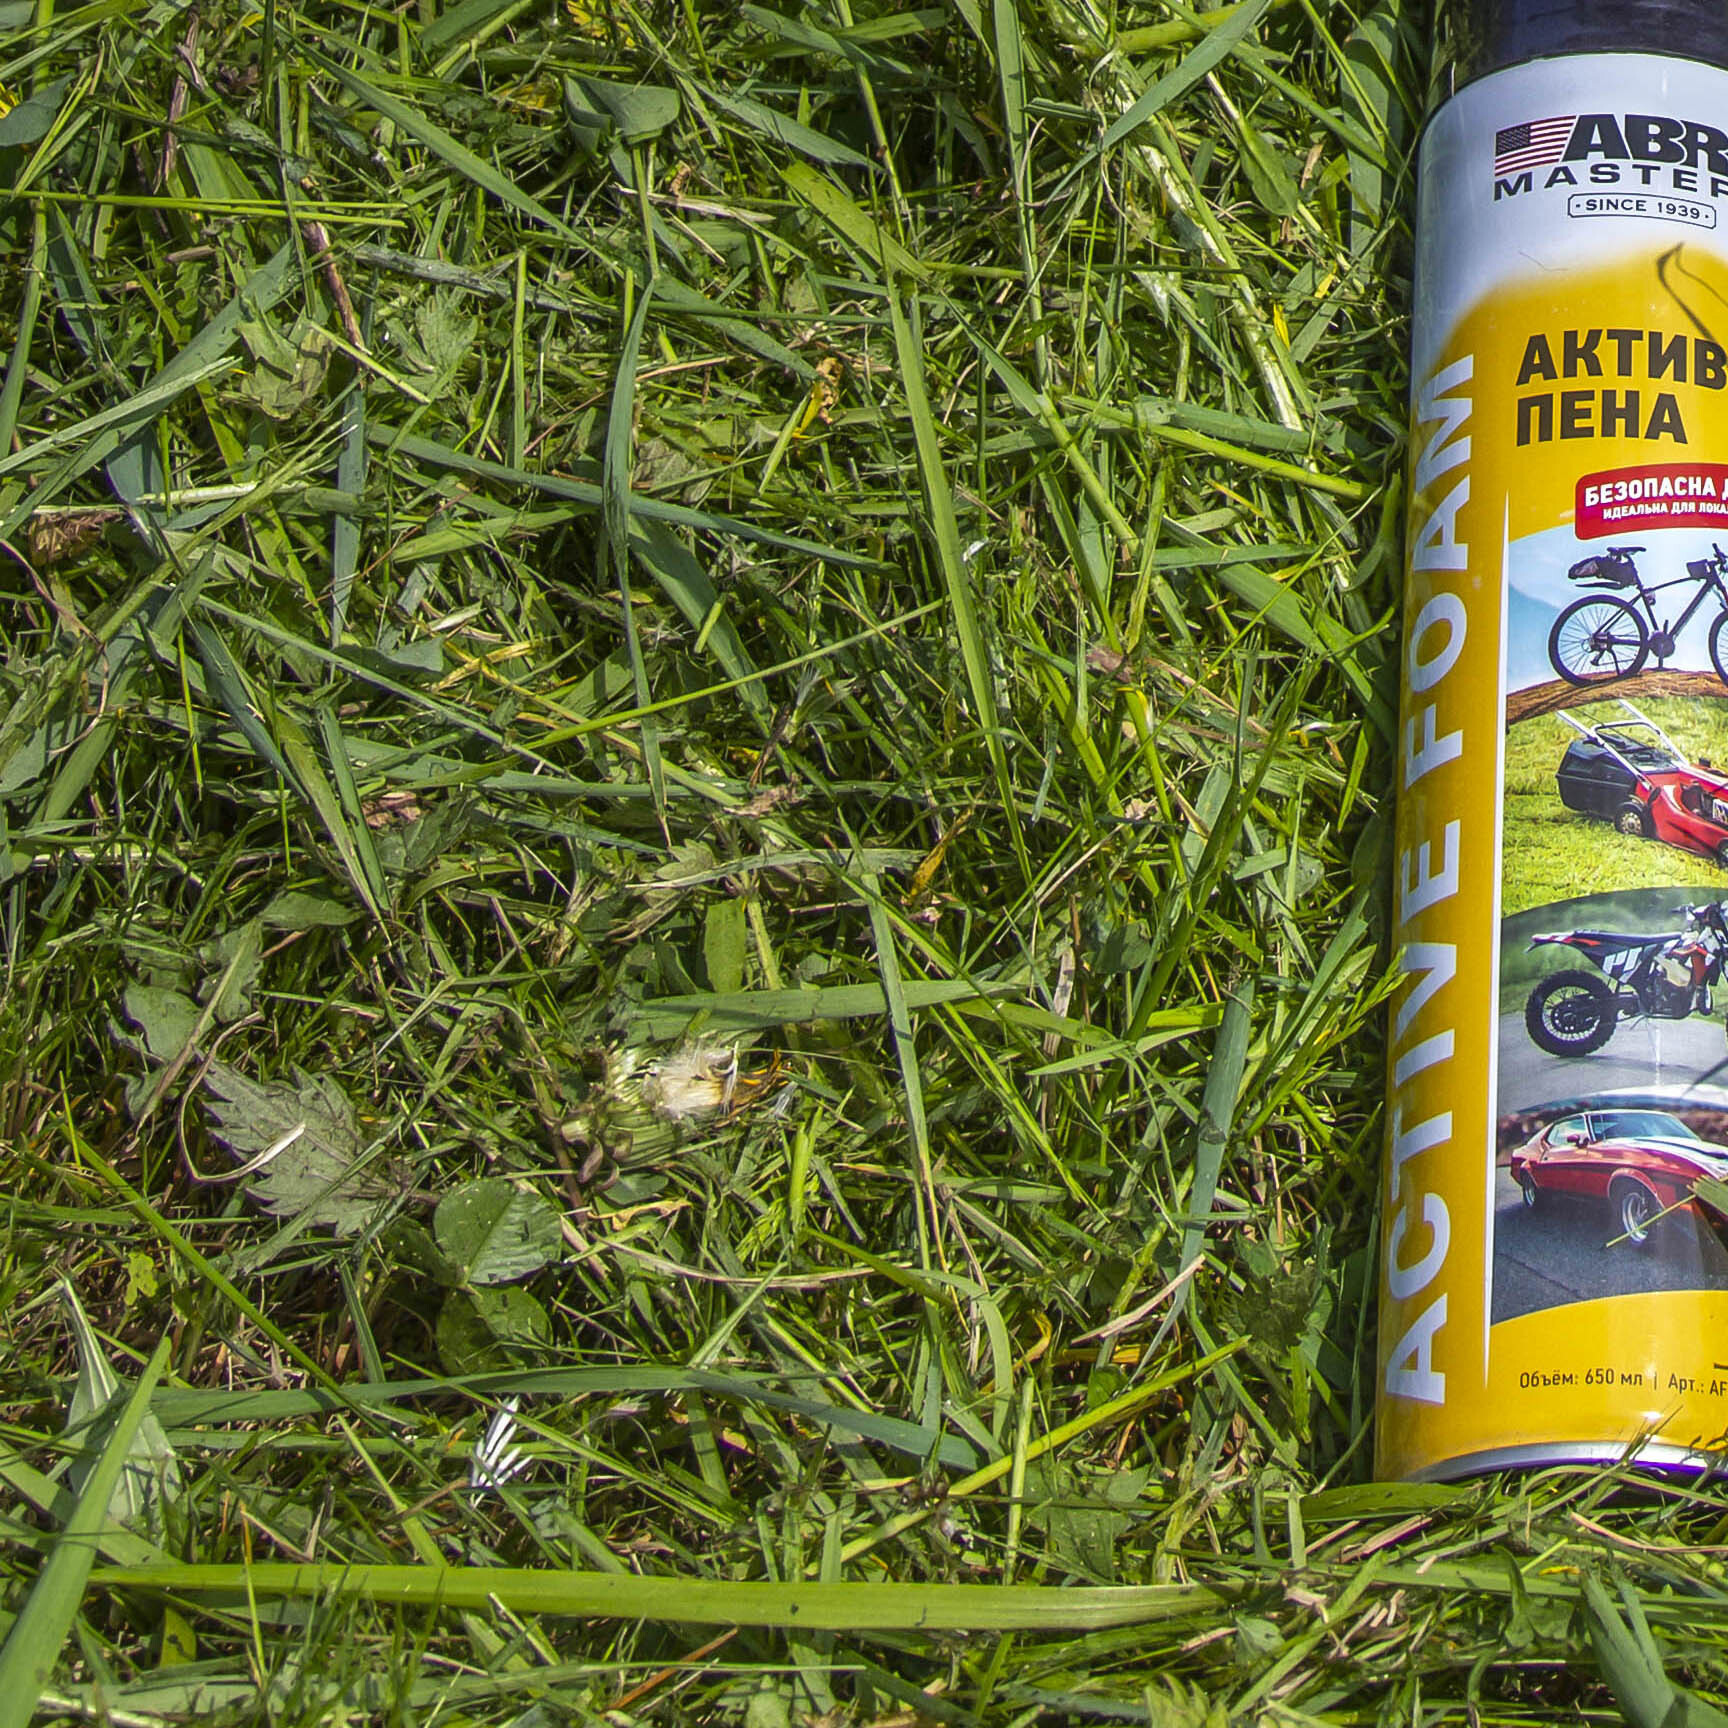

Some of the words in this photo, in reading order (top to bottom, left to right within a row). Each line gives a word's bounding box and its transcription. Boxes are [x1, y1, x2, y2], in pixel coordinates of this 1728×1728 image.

[1585, 198, 1647, 212] SINCE
[1657, 201, 1700, 220] 1939
[1516, 389, 1689, 447] ПЕНА
[1585, 477, 1717, 507] БЕЗОПАСНА
[1603, 502, 1668, 520] ИДЕАЛЬНА
[1671, 501, 1696, 515] ДЛЯ
[1404, 353, 1475, 791] FOAM
[1385, 818, 1462, 1405] ACTIVE
[1519, 1369, 1579, 1389] Объём:
[1585, 1368, 1615, 1385] 650
[1620, 1373, 1643, 1386] мл
[1668, 1373, 1704, 1394] Арт.:
